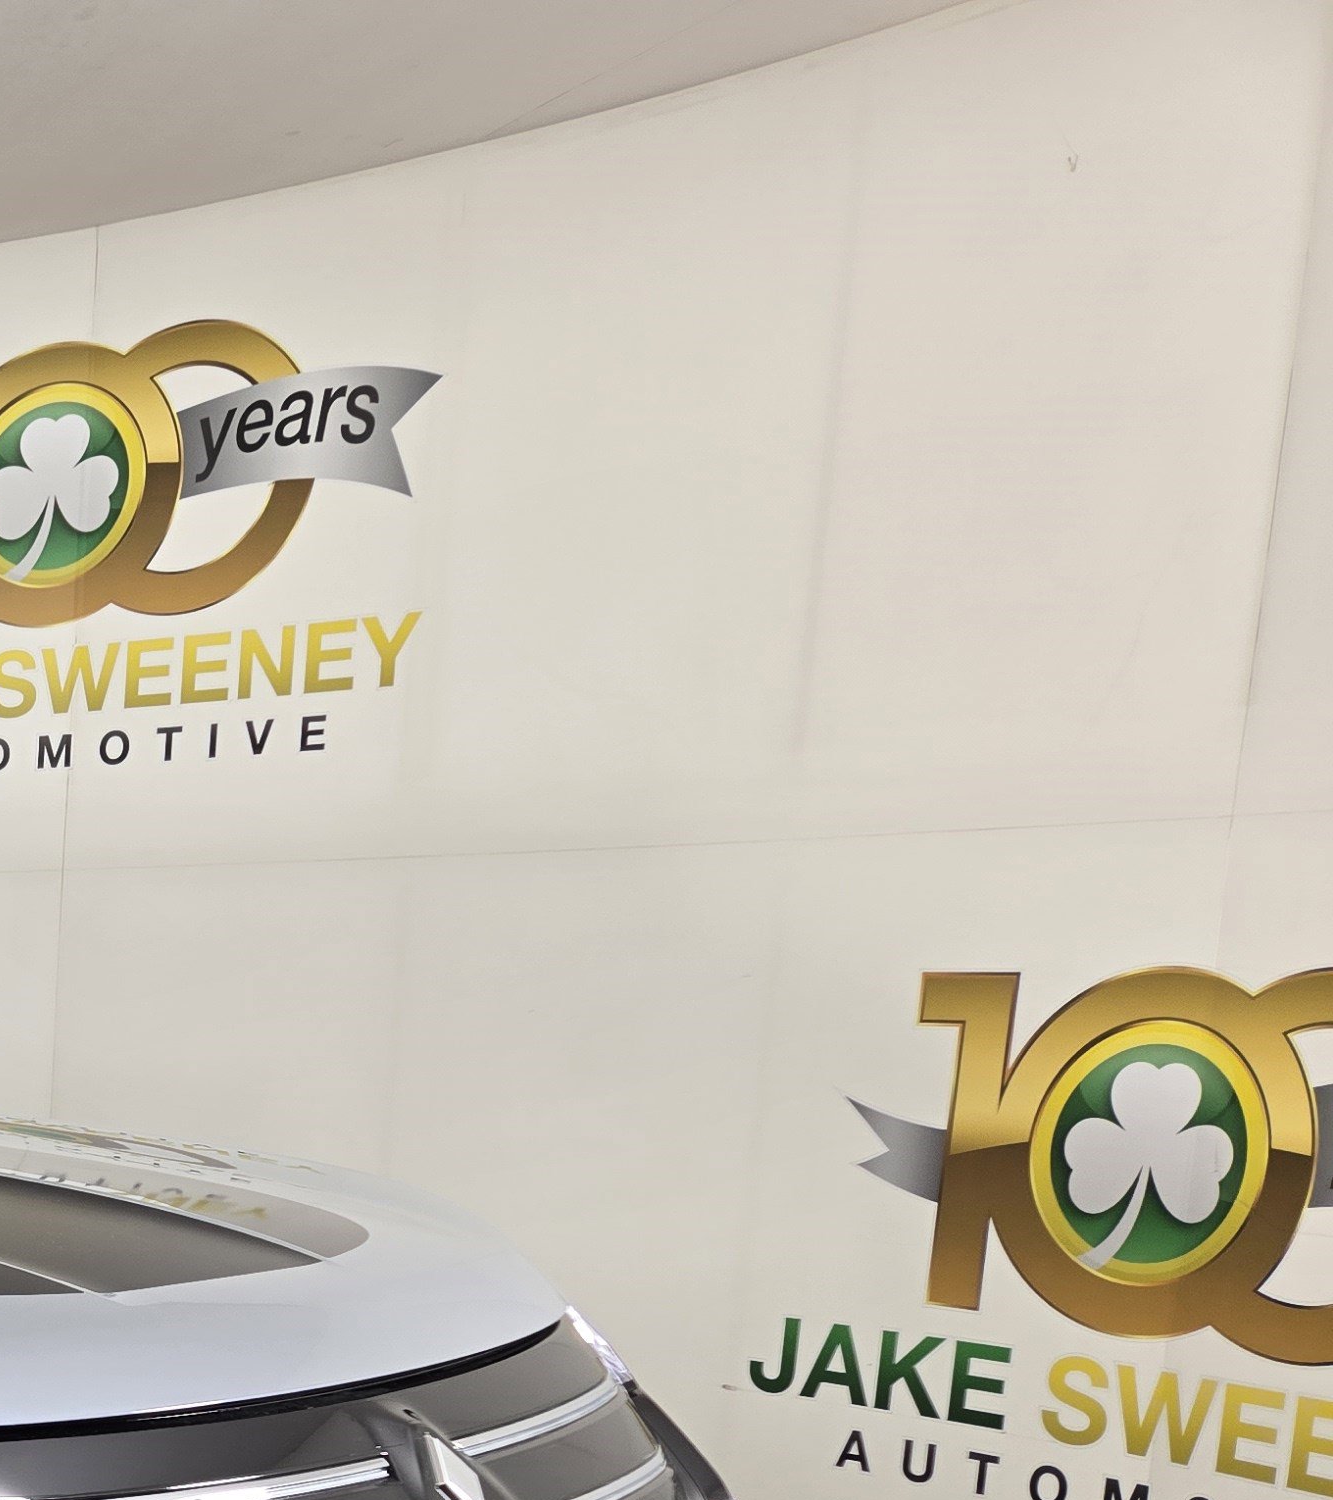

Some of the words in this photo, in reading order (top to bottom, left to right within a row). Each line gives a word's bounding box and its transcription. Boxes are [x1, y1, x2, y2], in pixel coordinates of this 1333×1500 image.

[195, 376, 380, 483] years
[748, 1317, 1012, 1430] JAKE
[1041, 1355, 1333, 1498] SWEE
